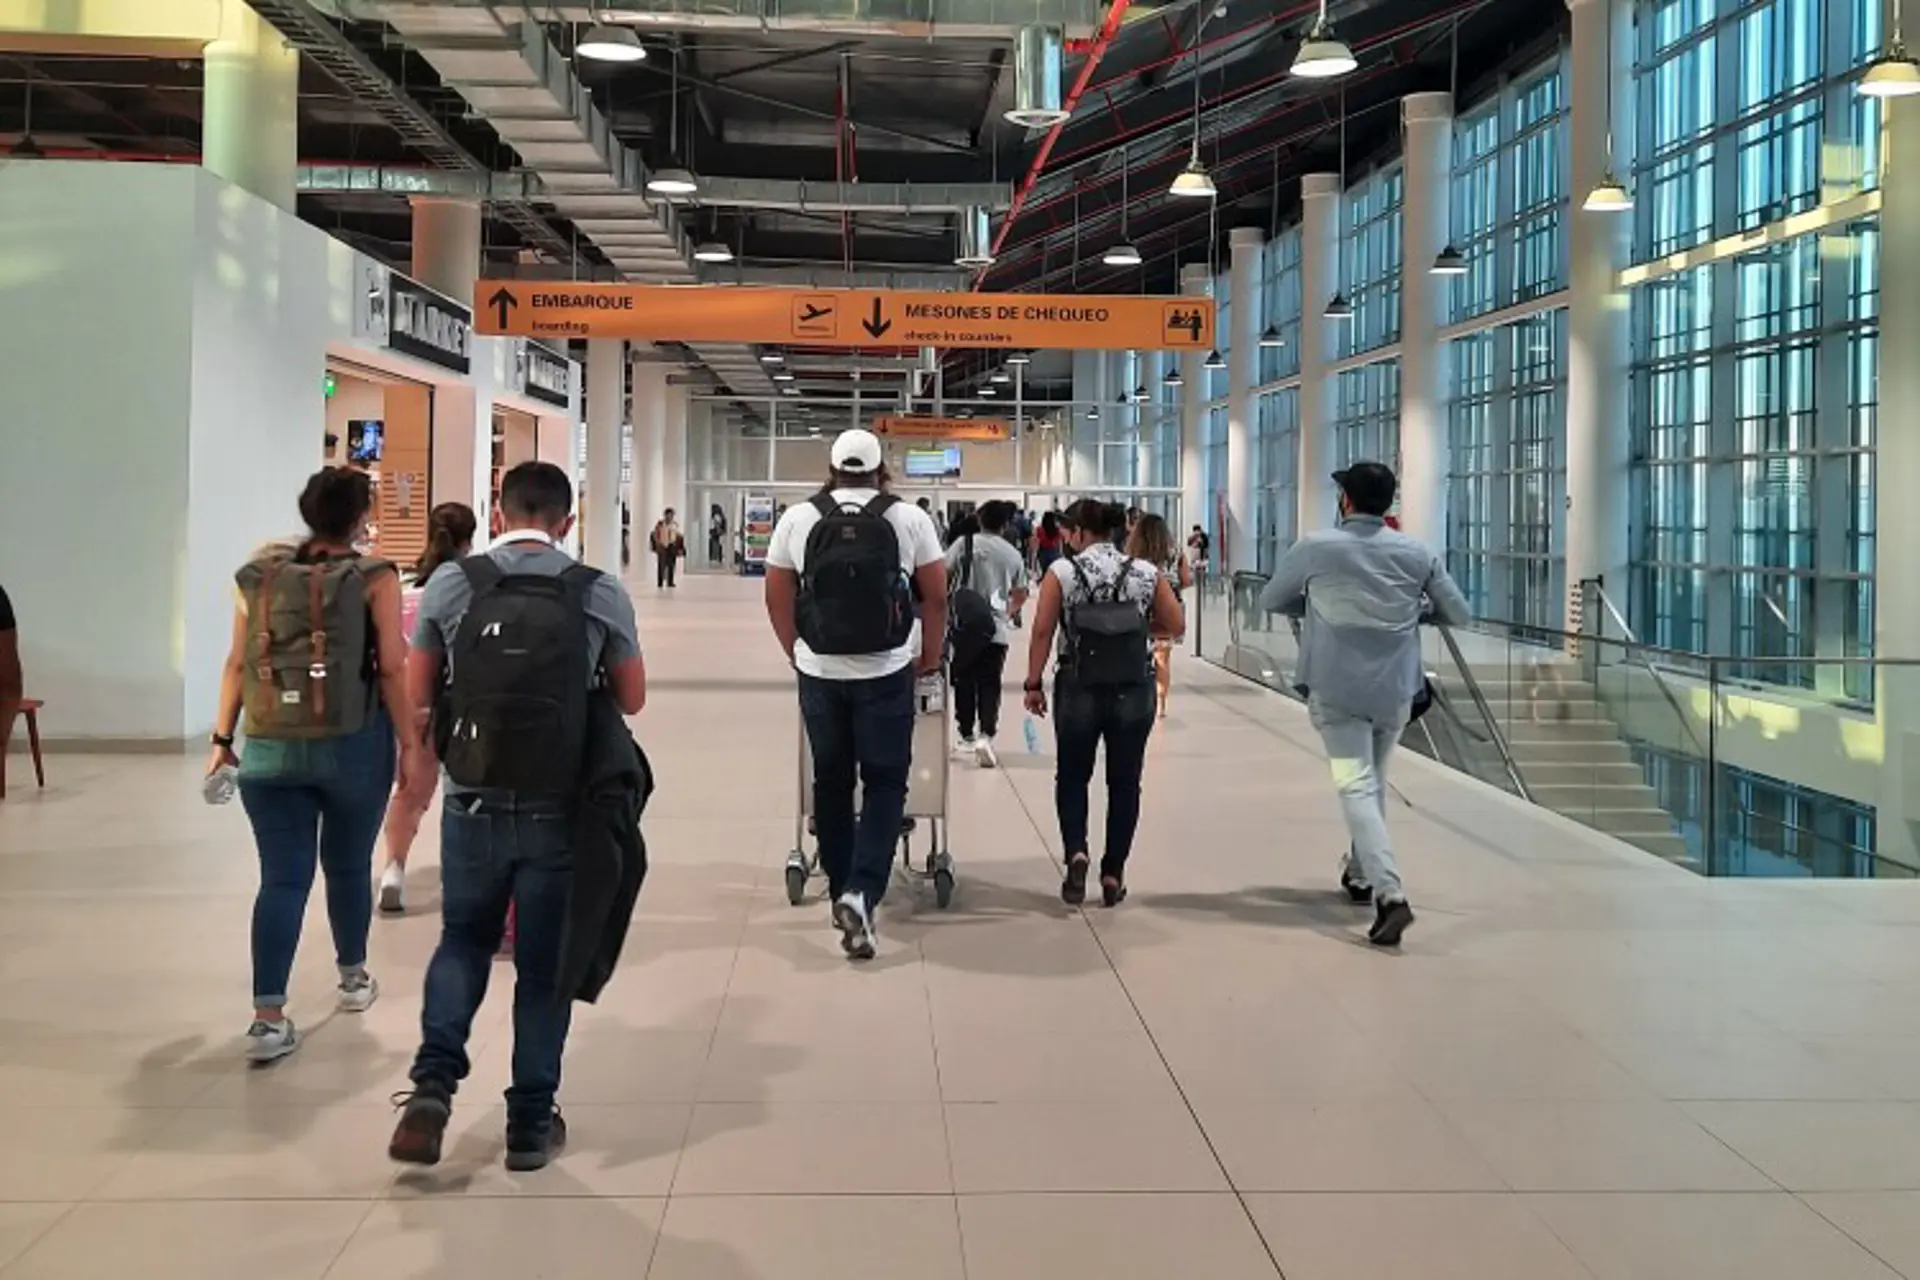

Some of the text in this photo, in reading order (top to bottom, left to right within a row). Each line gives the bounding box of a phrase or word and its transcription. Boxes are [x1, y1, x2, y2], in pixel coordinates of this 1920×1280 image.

[531, 293, 633, 310] EMBARQUE
[905, 303, 1109, 322] MESONES DE CHEQUEO
